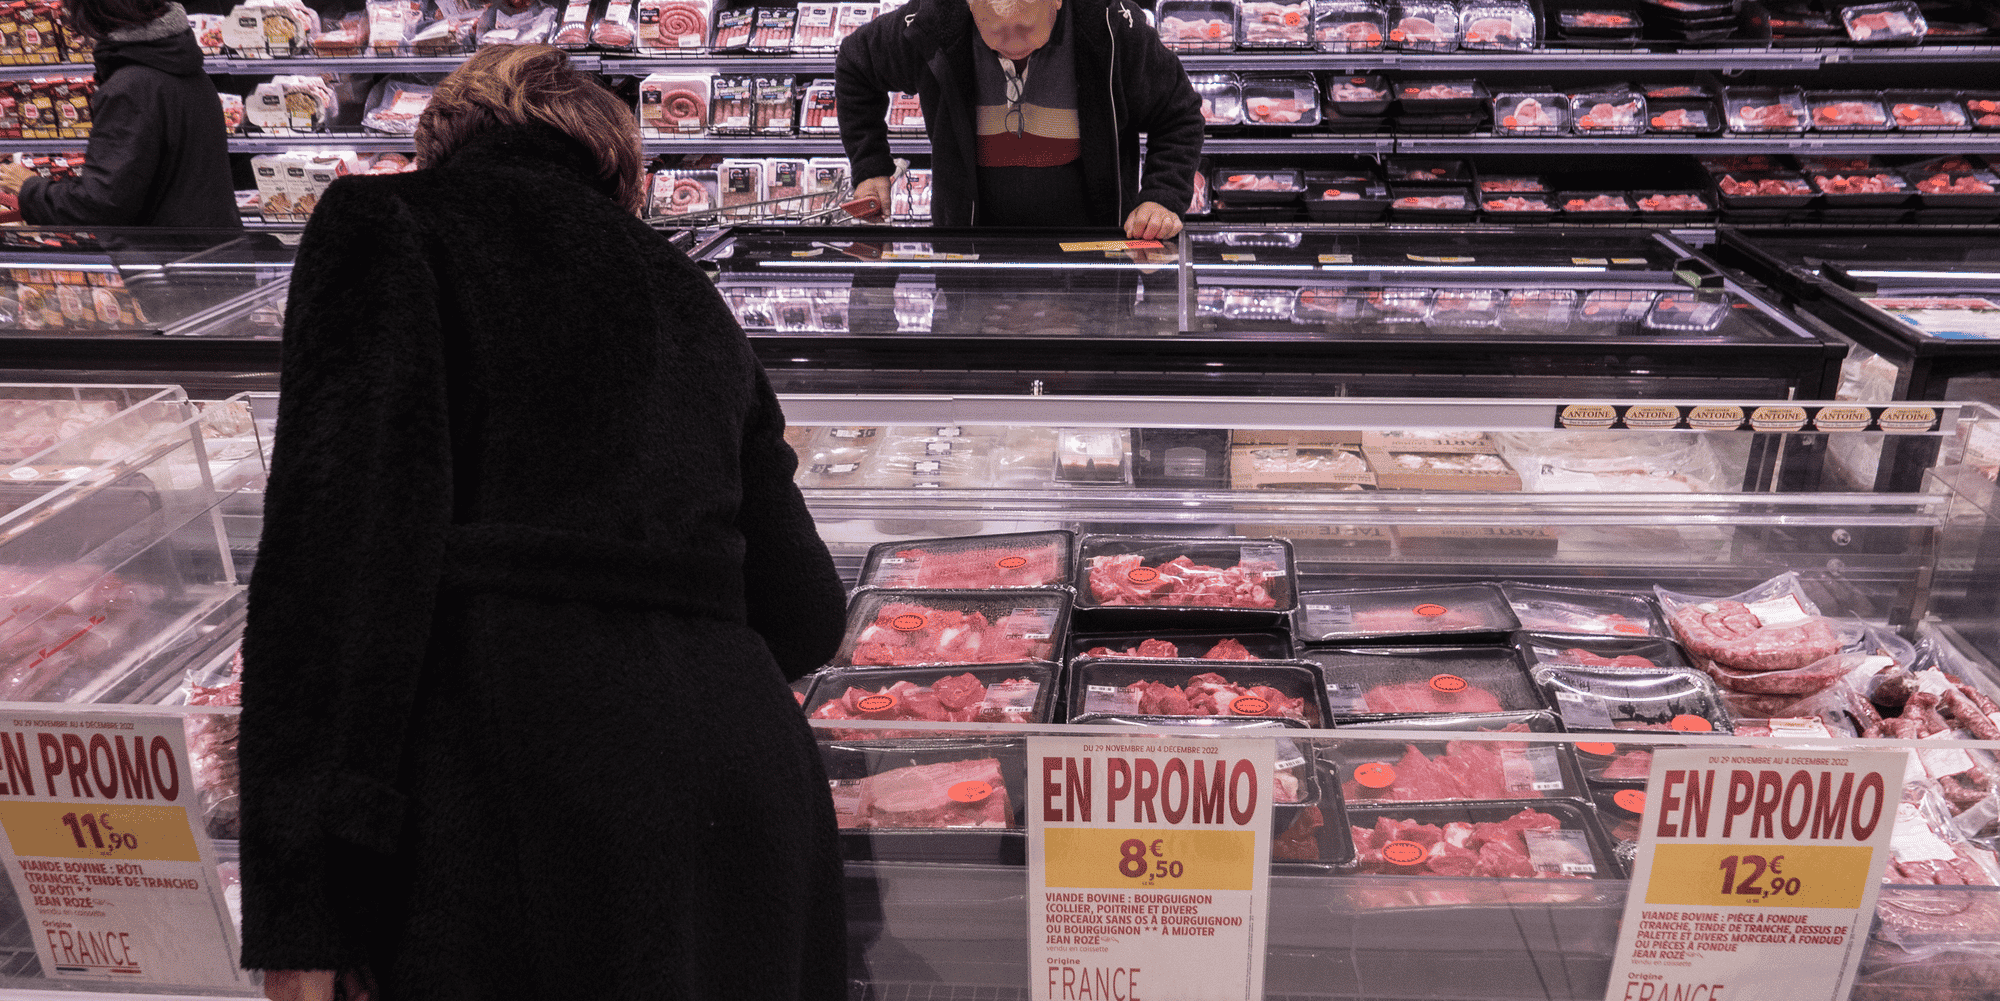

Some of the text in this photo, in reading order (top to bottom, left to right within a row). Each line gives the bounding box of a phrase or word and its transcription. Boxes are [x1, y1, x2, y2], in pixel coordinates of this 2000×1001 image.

[1569, 411, 1610, 419] ANTOINE
[1631, 411, 1673, 419] ANTOINE
[1083, 744, 1094, 752] DU
[1095, 744, 1104, 752] 29
[1105, 744, 1144, 753] NOVEMBRE
[1146, 745, 1156, 753] AU
[1157, 745, 1162, 753] 4
[1202, 747, 1219, 755] 2022
[0, 731, 179, 801] N PROMO
[1708, 756, 1720, 764] DU
[1720, 756, 1731, 764] 29
[1731, 756, 1772, 765] NOVEMBRE
[1772, 757, 1784, 765] AU
[1830, 758, 1849, 767] 2022
[1043, 757, 1258, 825] EN PROMO
[1656, 769, 1885, 842] EN PROMO
[18, 860, 63, 872] VIANDE
[64, 861, 108, 874] BOVINE
[85, 874, 123, 886] TENDE
[124, 876, 141, 887] DE
[141, 877, 198, 890] TRANCHE)
[29, 884, 46, 894] OU
[34, 896, 62, 907] JEAN
[1045, 892, 1085, 903] VIANDE
[1086, 893, 1125, 904] BOVINE
[1134, 894, 1213, 905] BOURGUIGNON
[1045, 902, 1198, 915] (COLLIER, POITRINE ET DIVERS
[1046, 914, 1103, 924] MORCEAUX
[1105, 914, 1132, 925] SANS
[1134, 915, 1148, 925] OS
[1161, 915, 1243, 927] BOURGUIGNON)
[1641, 911, 1679, 922] VIANDE
[1681, 912, 1720, 922] BOVINE
[1766, 914, 1808, 924] FONDUE
[42, 920, 72, 929] Origine
[1046, 924, 1061, 934] OU
[1064, 925, 1141, 935] BOURGUIGNON
[1172, 926, 1215, 936] MIJOTER
[1639, 920, 1848, 935] (TRANCHE, TENDE DE TRANCHE, DESSUS DE
[1046, 935, 1071, 945] JEAN
[1636, 930, 1679, 940] PALETTE
[1680, 931, 1692, 941] ET
[1693, 932, 1729, 942] DIVERS
[1731, 933, 1787, 944] MORCEAUX
[1798, 935, 1843, 945] FONDUE)
[46, 929, 138, 966] FRANCE
[1635, 940, 1650, 949] OU
[1696, 942, 1738, 952] FONDUE
[1632, 949, 1656, 959] JEAN
[1046, 957, 1081, 966] Origine
[1627, 972, 1664, 981] Origine
[1048, 966, 1141, 1001] FRANCE
